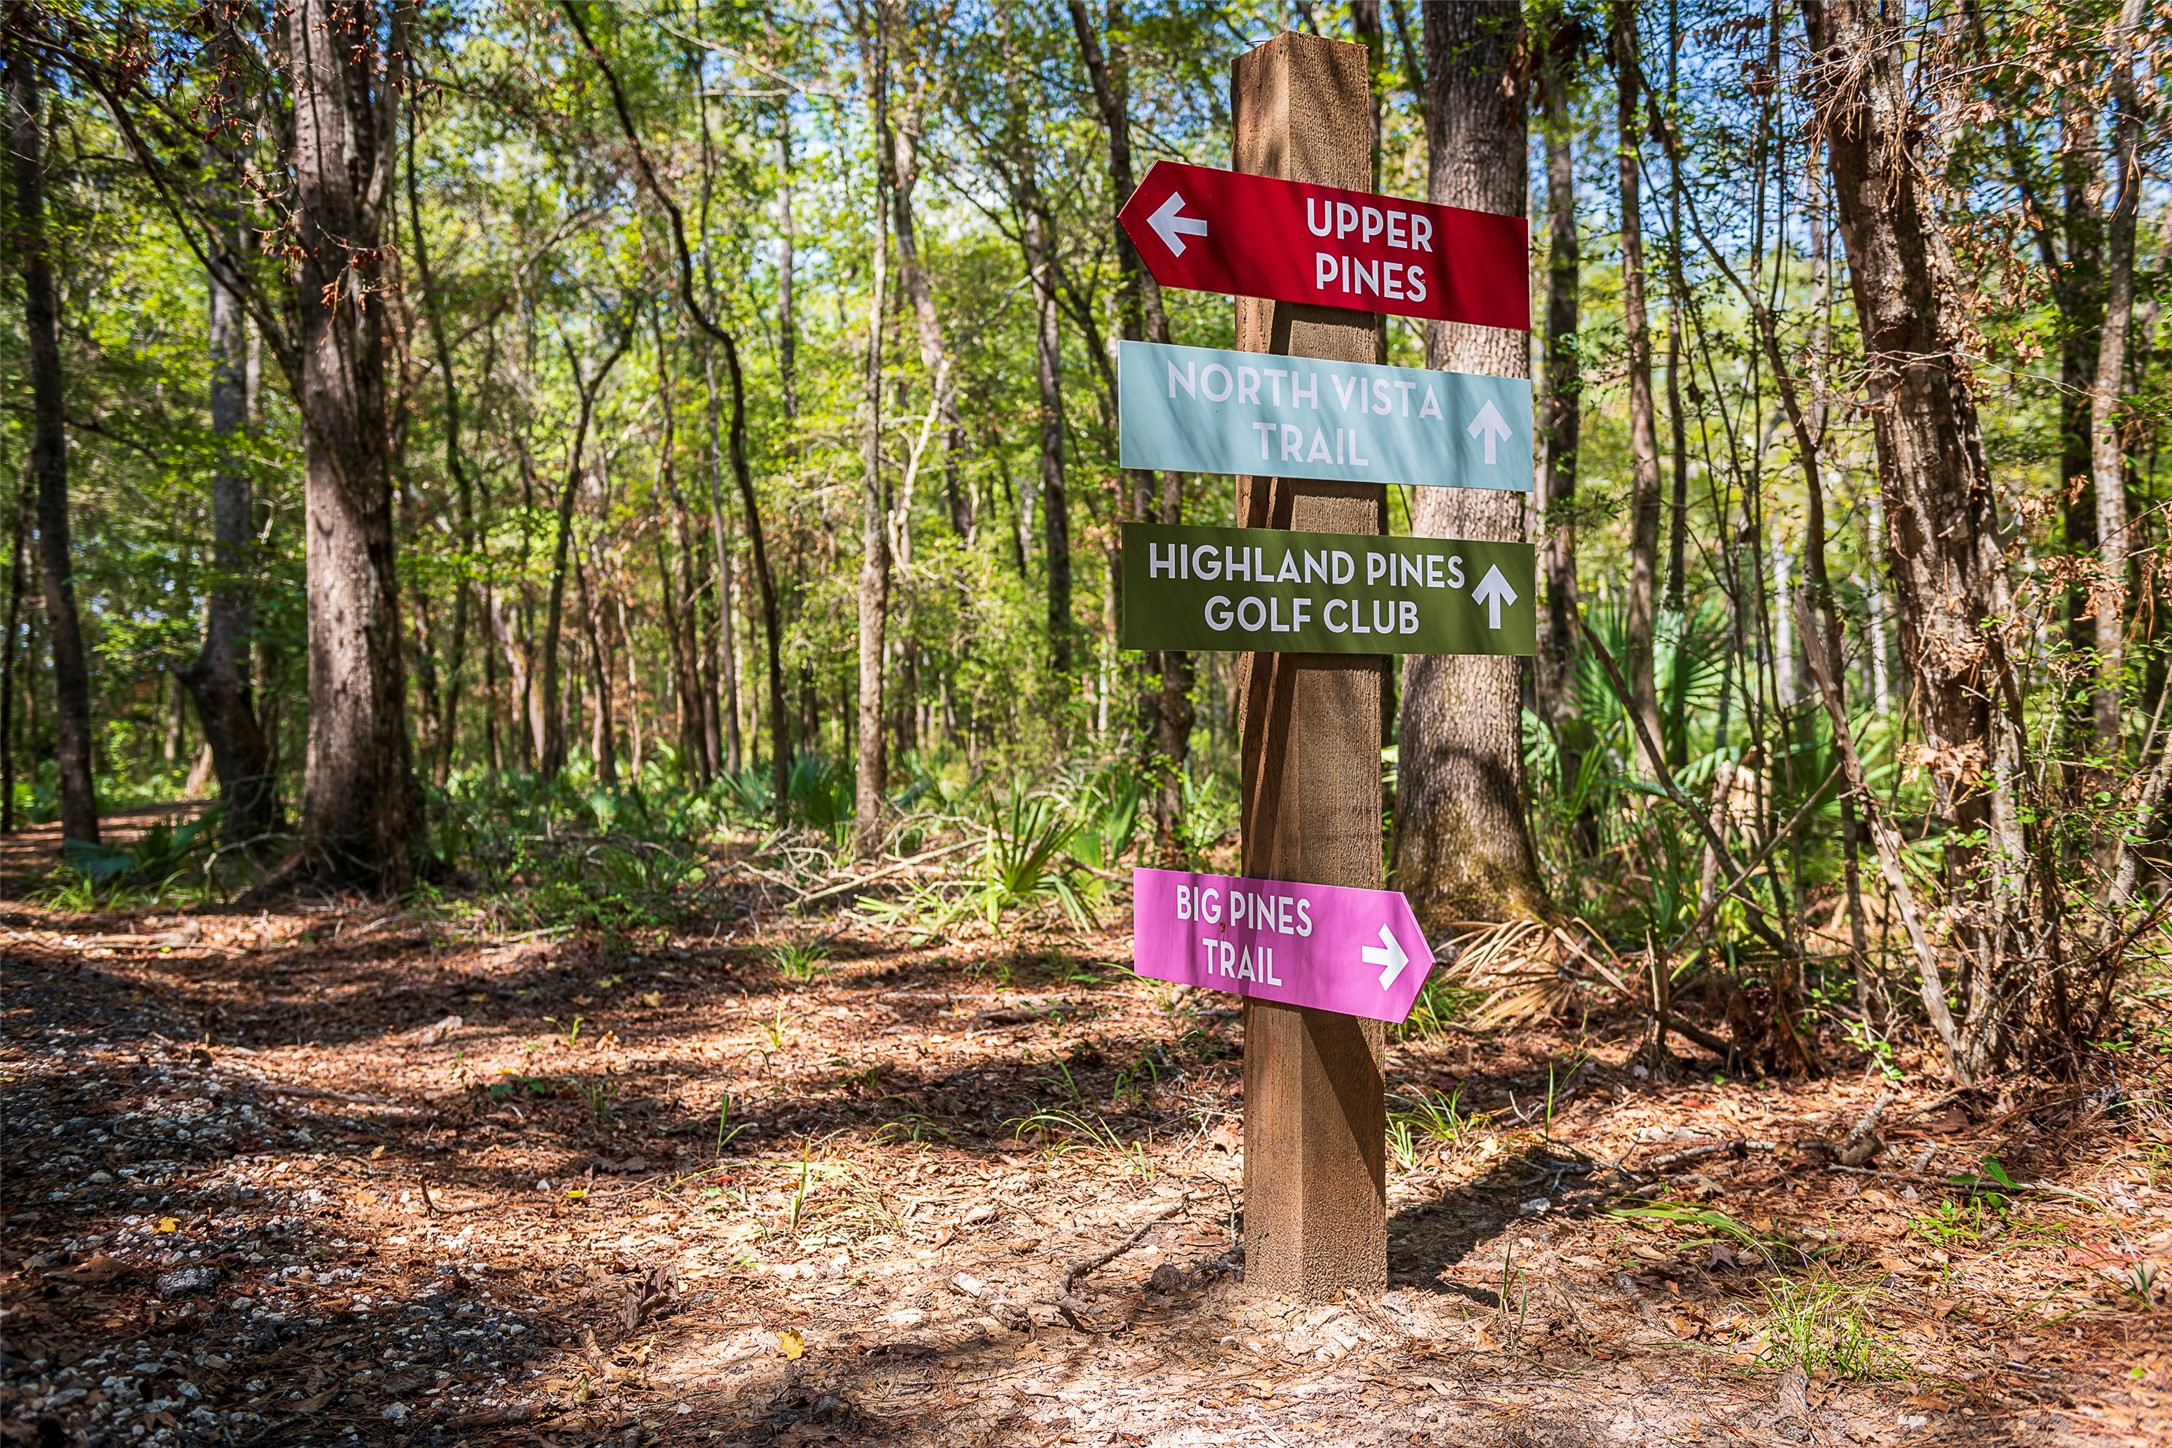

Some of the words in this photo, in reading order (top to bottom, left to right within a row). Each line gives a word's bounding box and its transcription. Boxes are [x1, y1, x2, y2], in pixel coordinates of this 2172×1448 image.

[1307, 197, 1433, 253] UPPER
[1316, 252, 1427, 303] PINES
[1168, 360, 1318, 410] NORTH
[1331, 374, 1444, 421] VISTA
[1252, 421, 1369, 467] TRAIL
[1149, 542, 1355, 585] HIGHLAND
[1367, 552, 1465, 589] PINES
[1204, 595, 1311, 633] GOLF
[1323, 598, 1419, 635] CLUB
[1176, 884, 1222, 925] BIG
[1230, 890, 1313, 938] PINES
[1202, 937, 1283, 987] TRAIL
